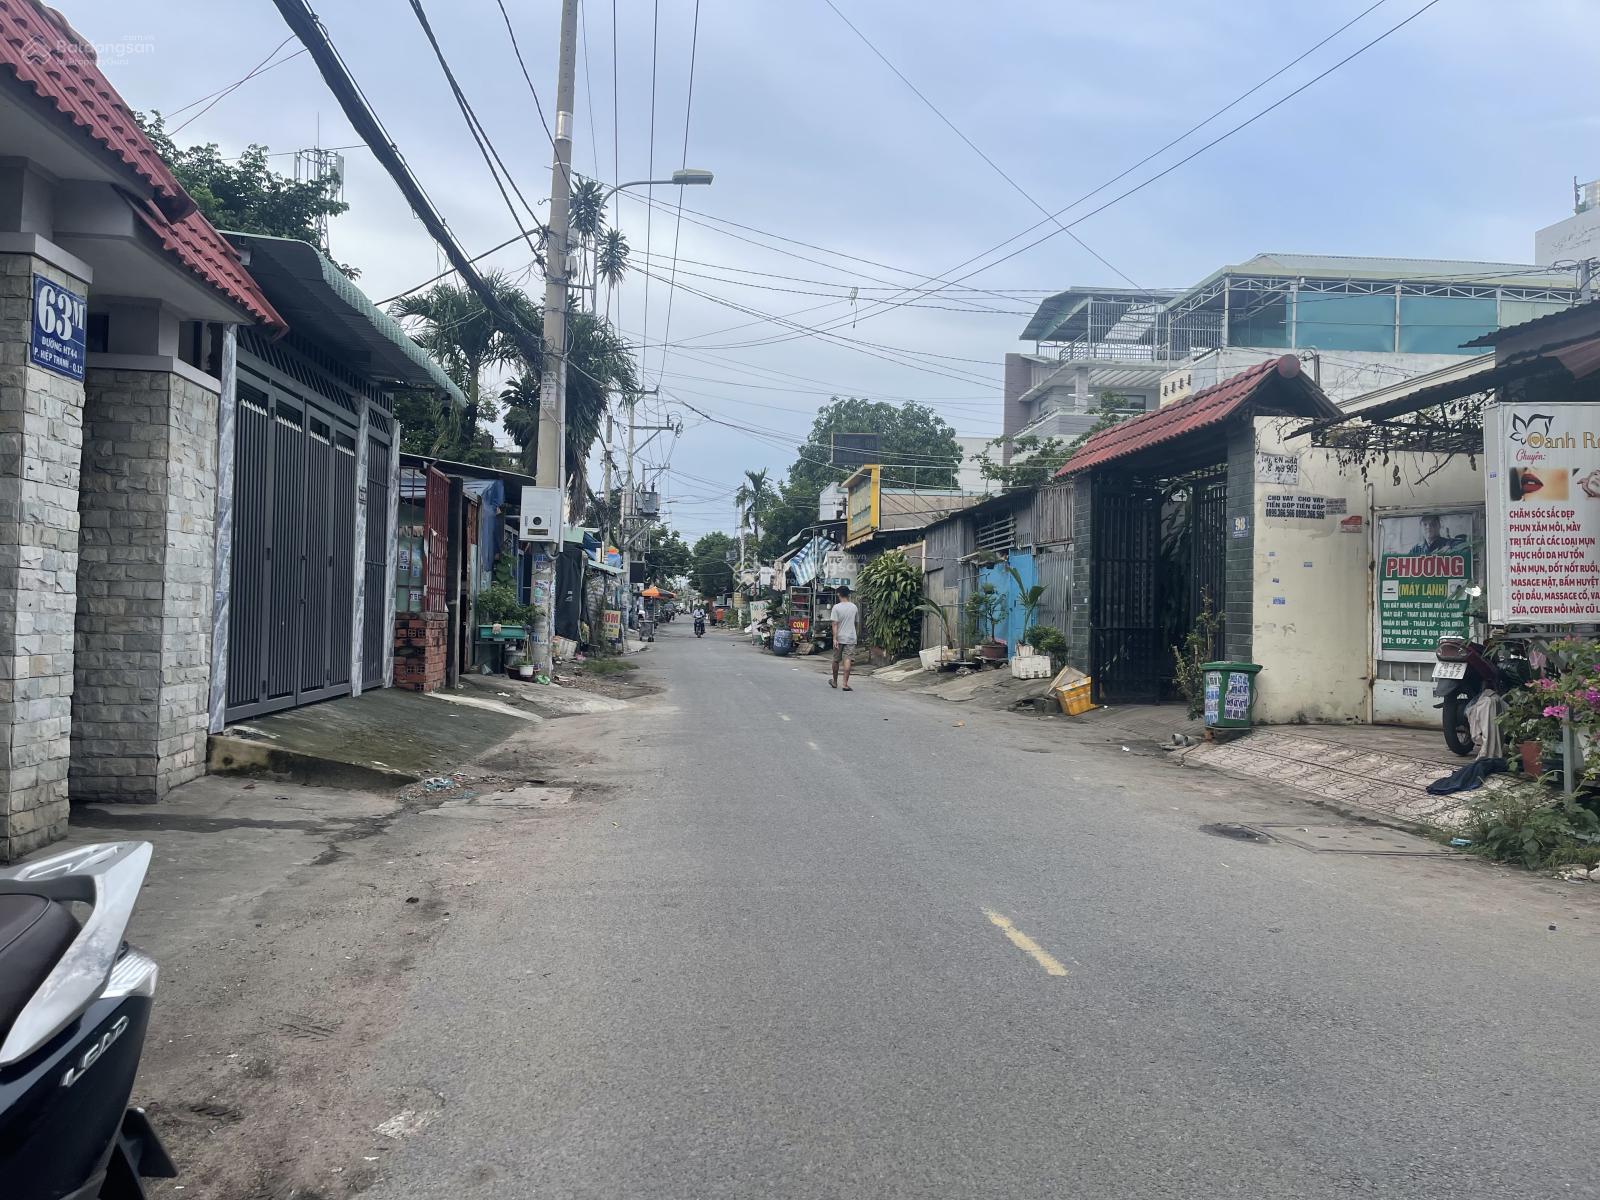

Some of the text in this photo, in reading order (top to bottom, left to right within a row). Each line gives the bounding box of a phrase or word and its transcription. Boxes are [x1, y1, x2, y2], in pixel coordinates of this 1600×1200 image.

[1527, 432, 1576, 448] Oanh
[1509, 506, 1575, 520] CHĂM SÓC SẮC ĐẸP
[1532, 522, 1547, 532] XĂM
[1566, 521, 1581, 532] MÀY
[1509, 533, 1595, 548] TRỊ TẤT CẢ CÁC LOẠI MỤN
[1510, 552, 1531, 561] PHỤC
[1386, 554, 1464, 577] PHƯƠNG
[1510, 562, 1526, 575] NẶN
[1549, 561, 1562, 572] ĐỐT
[1564, 561, 1578, 572] NỐT
[1560, 574, 1575, 586] BẤM
[1577, 576, 1598, 588] HUYỆT
[1511, 590, 1524, 602] GỘI
[1554, 603, 1568, 613] MÔI
[1569, 603, 1584, 613] MÀY
[1586, 604, 1595, 613] CŨ
[59, 1015, 130, 1088] LEAD
